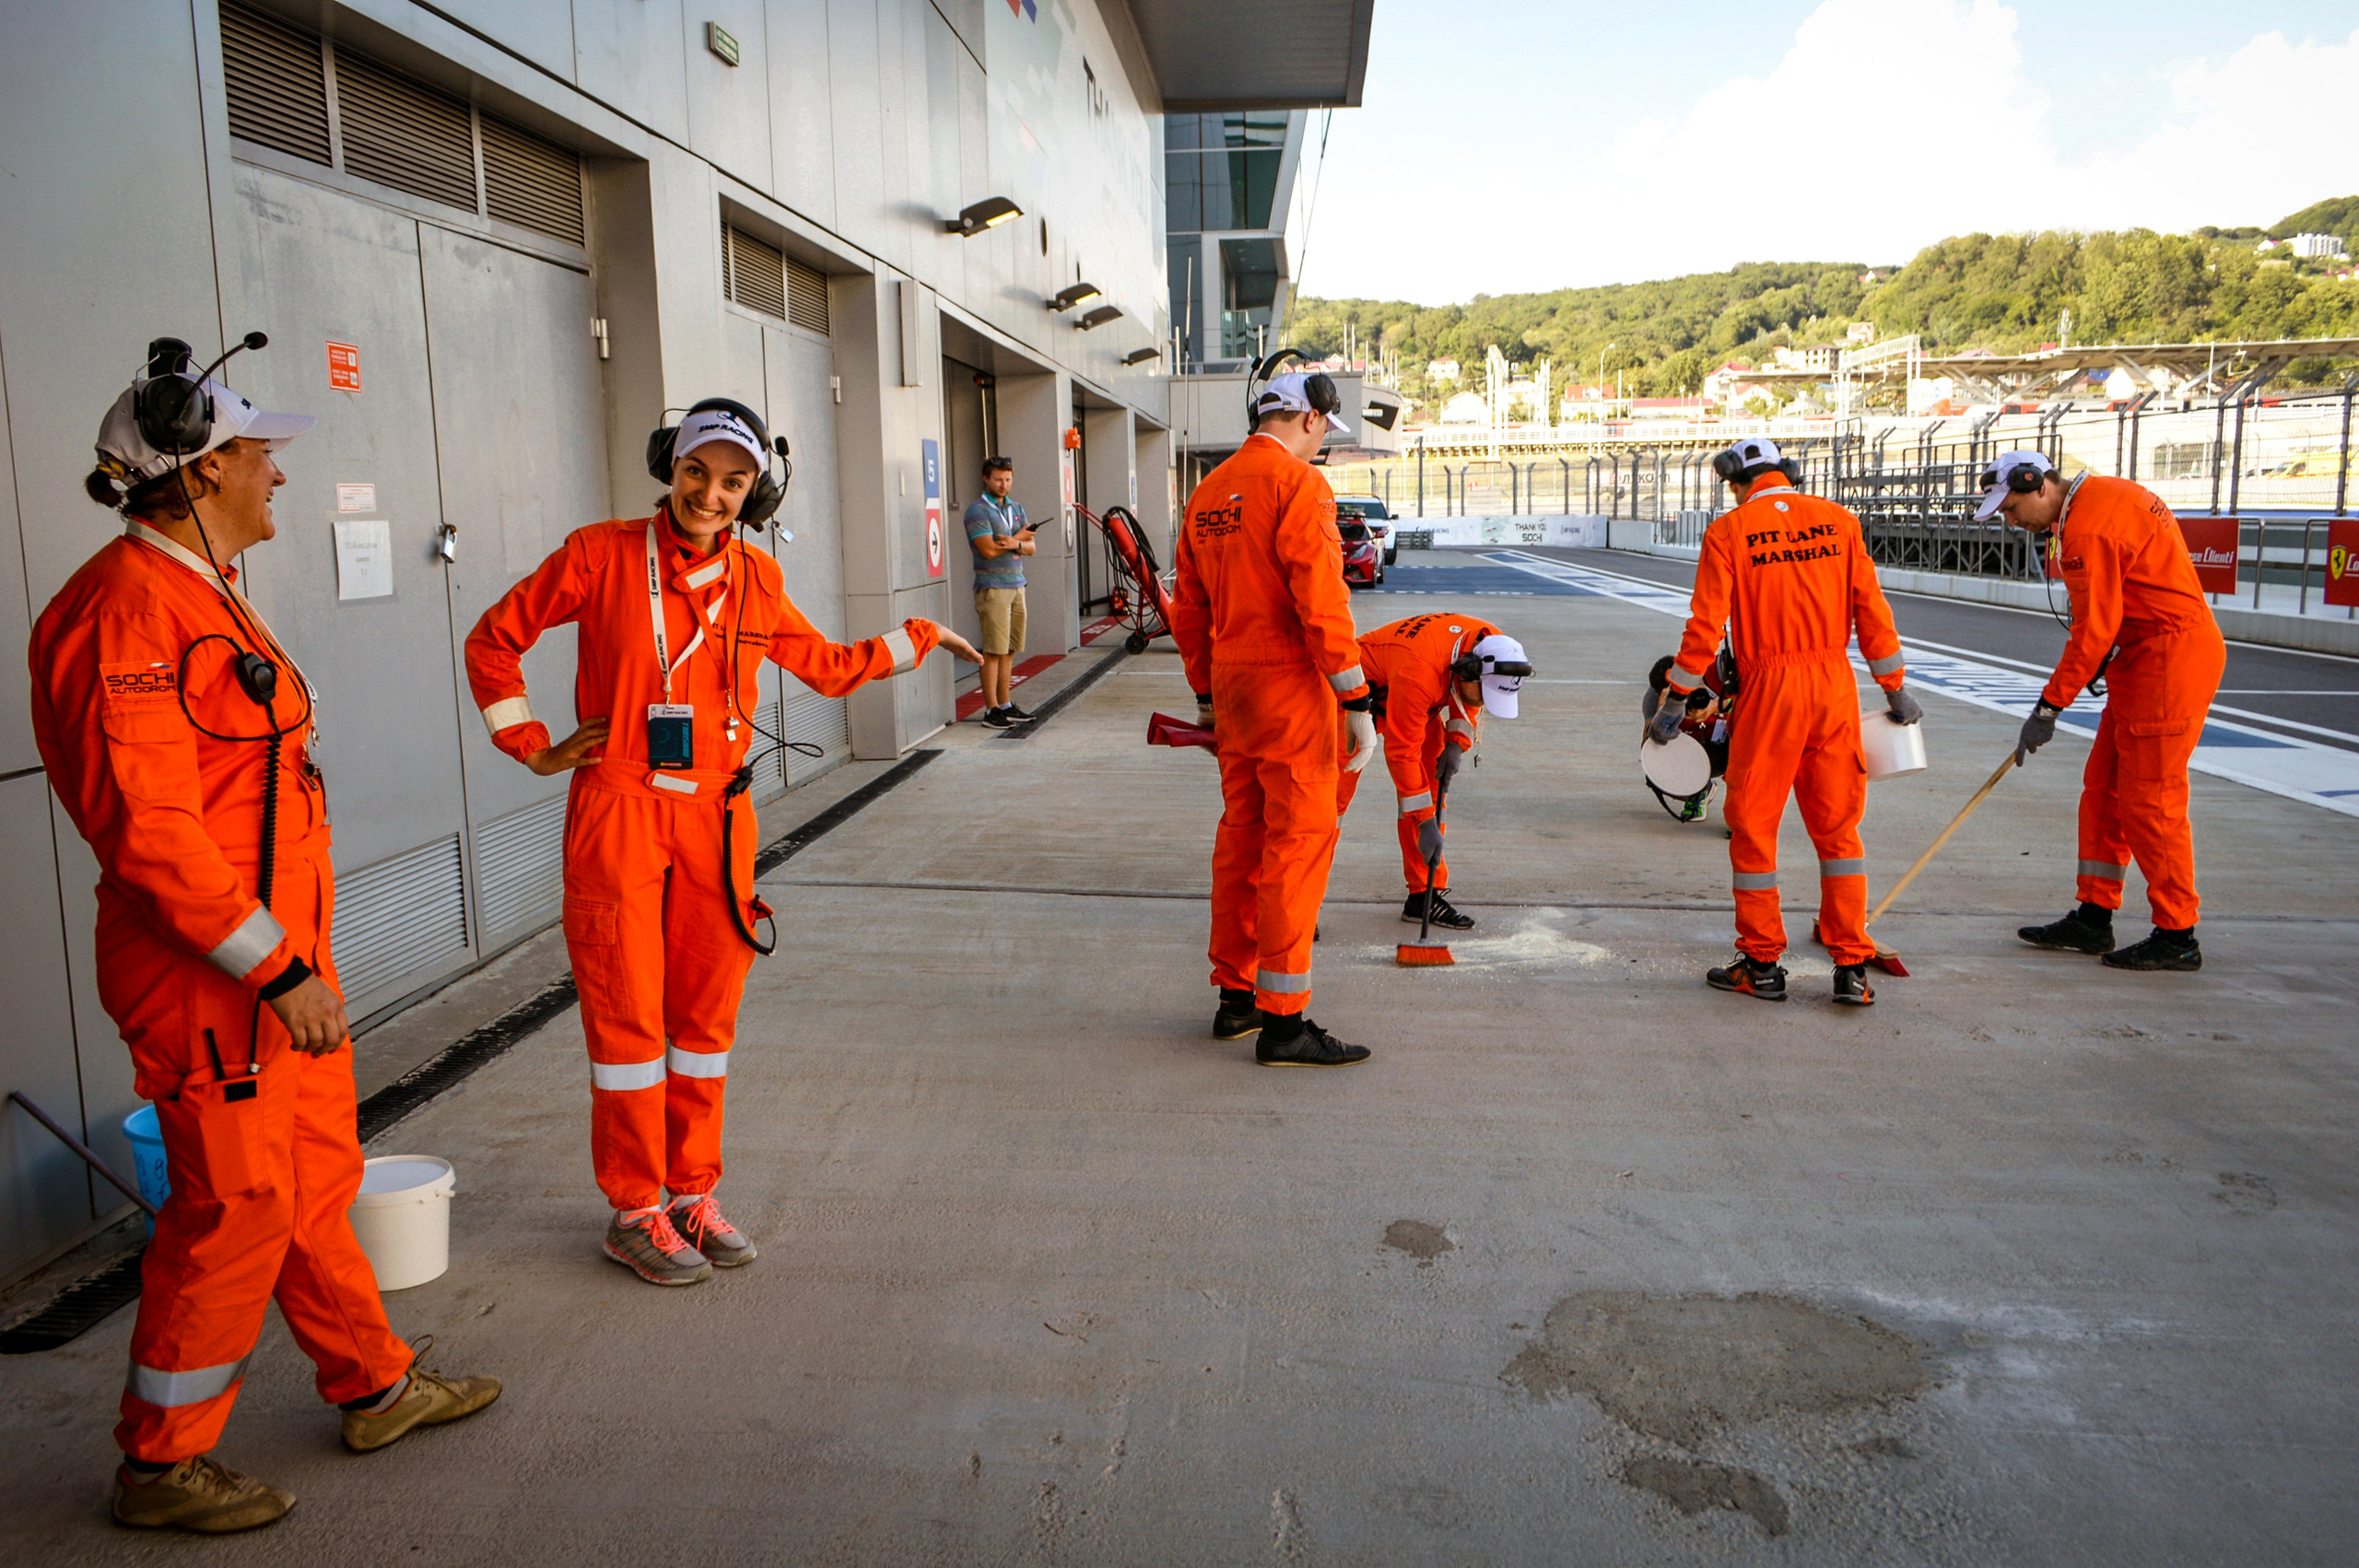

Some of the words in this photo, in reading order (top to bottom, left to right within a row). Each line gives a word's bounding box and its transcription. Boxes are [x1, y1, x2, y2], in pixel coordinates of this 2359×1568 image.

[698, 424, 720, 433] SMP
[721, 425, 754, 443] RACING
[928, 459, 934, 482] 5
[1622, 473, 1671, 484] ЛКОЛ
[1196, 507, 1242, 528] SOCHI
[1515, 523, 1537, 532] THANK
[1745, 531, 1780, 548] PIT
[1785, 524, 1837, 544] LANE
[1751, 544, 1841, 568] MARSHAL
[2203, 546, 2235, 564] Clienti
[105, 672, 175, 687] SOCHI
[110, 684, 176, 695] AUTODROM
